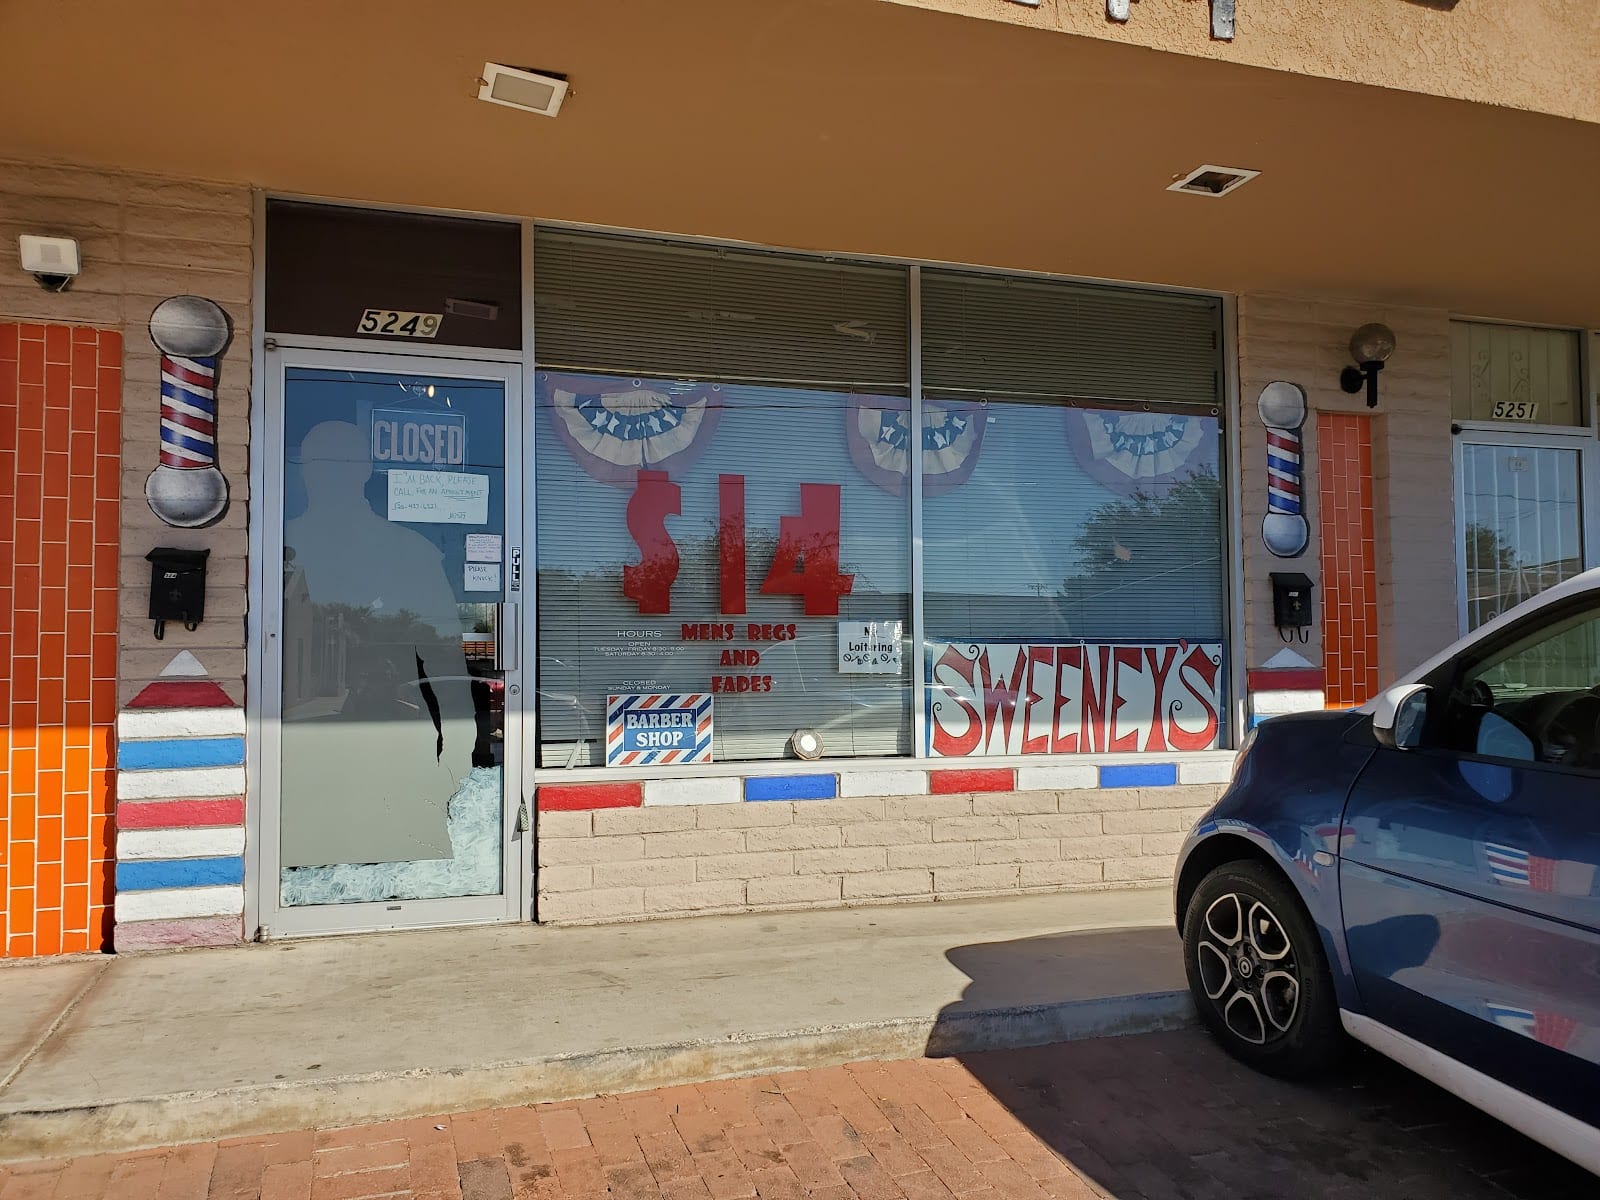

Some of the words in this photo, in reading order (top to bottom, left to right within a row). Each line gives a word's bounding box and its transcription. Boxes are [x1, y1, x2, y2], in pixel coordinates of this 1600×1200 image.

[361, 311, 438, 336] 5249
[1494, 401, 1535, 419] 5251
[373, 420, 463, 465] CLOSED
[393, 487, 414, 497] CALL
[623, 469, 855, 616] $14
[512, 549, 520, 581] PULL
[617, 630, 662, 638] HOURS
[681, 623, 734, 641] MENS
[747, 623, 797, 641] REGS
[848, 641, 893, 653] Loitring
[719, 649, 761, 667] AND
[711, 675, 772, 694] FADES
[932, 638, 1222, 757] SWEENEY'S
[626, 712, 694, 729] BARBER
[635, 731, 684, 747] SHOP
